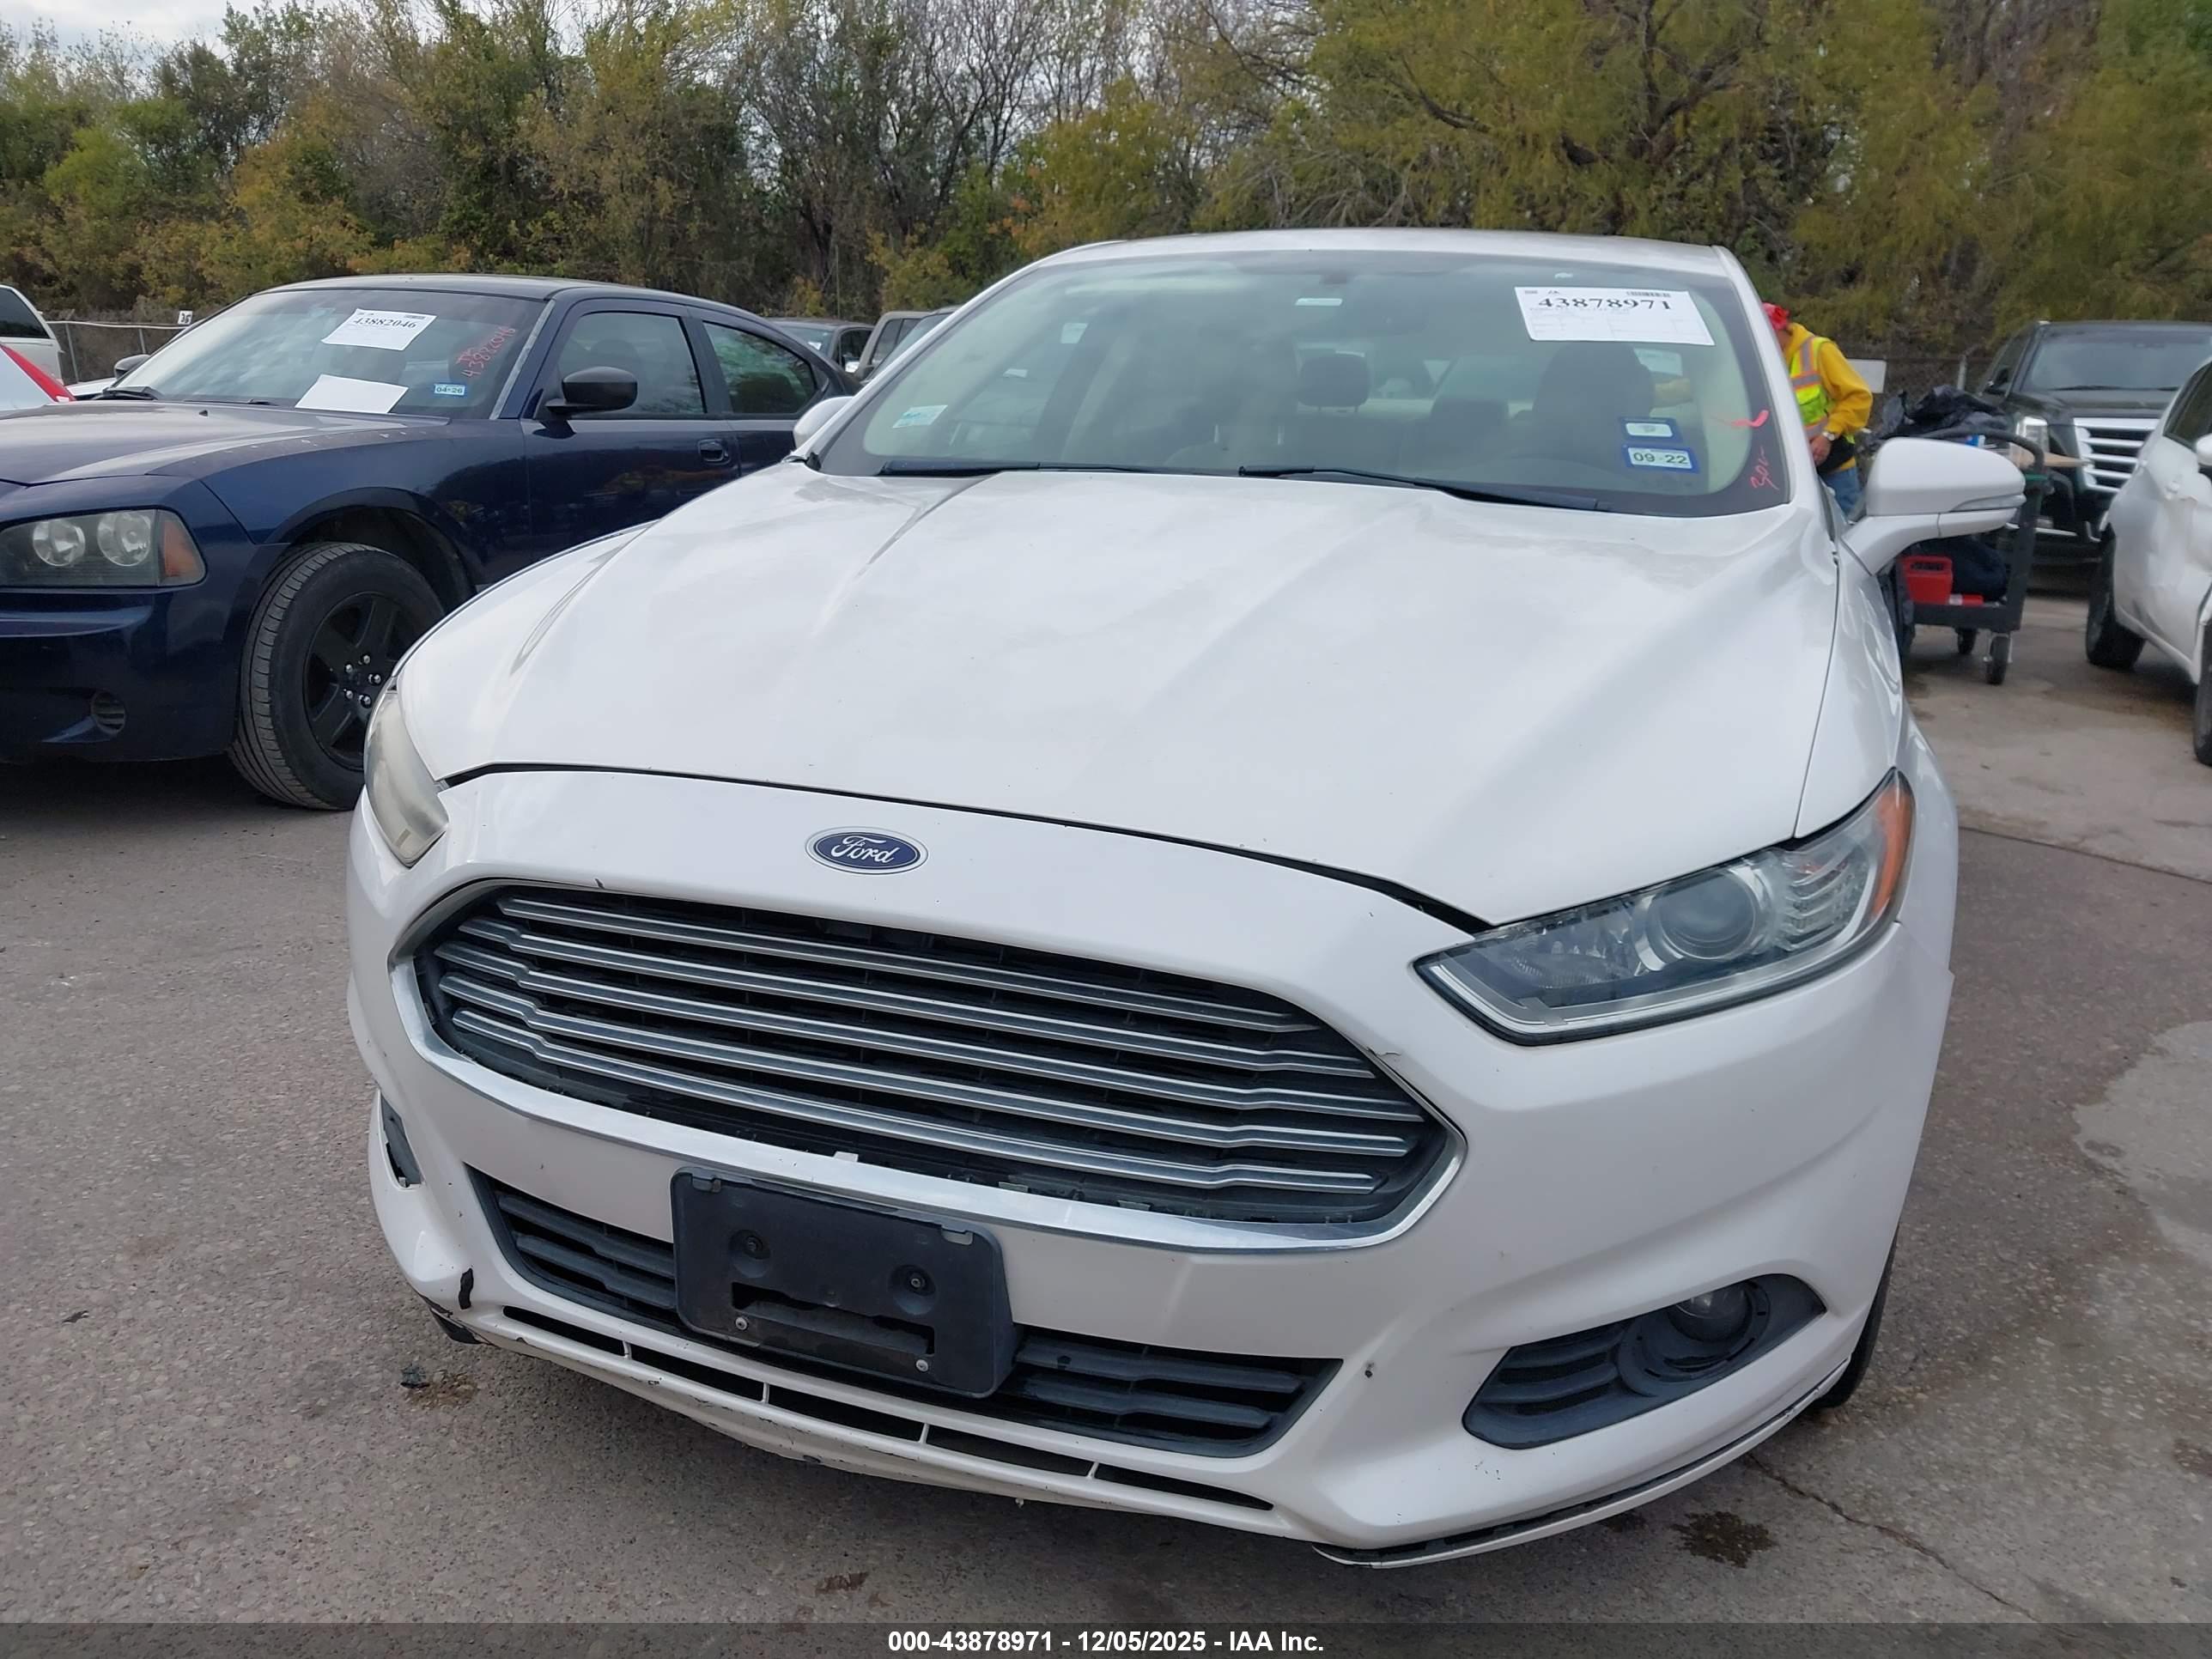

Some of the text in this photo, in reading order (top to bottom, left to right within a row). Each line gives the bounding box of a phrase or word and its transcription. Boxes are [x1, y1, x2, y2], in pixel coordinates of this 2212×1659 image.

[1538, 297, 1672, 310] 43878971
[353, 317, 416, 329] 43882046
[830, 835, 901, 864] Ford
